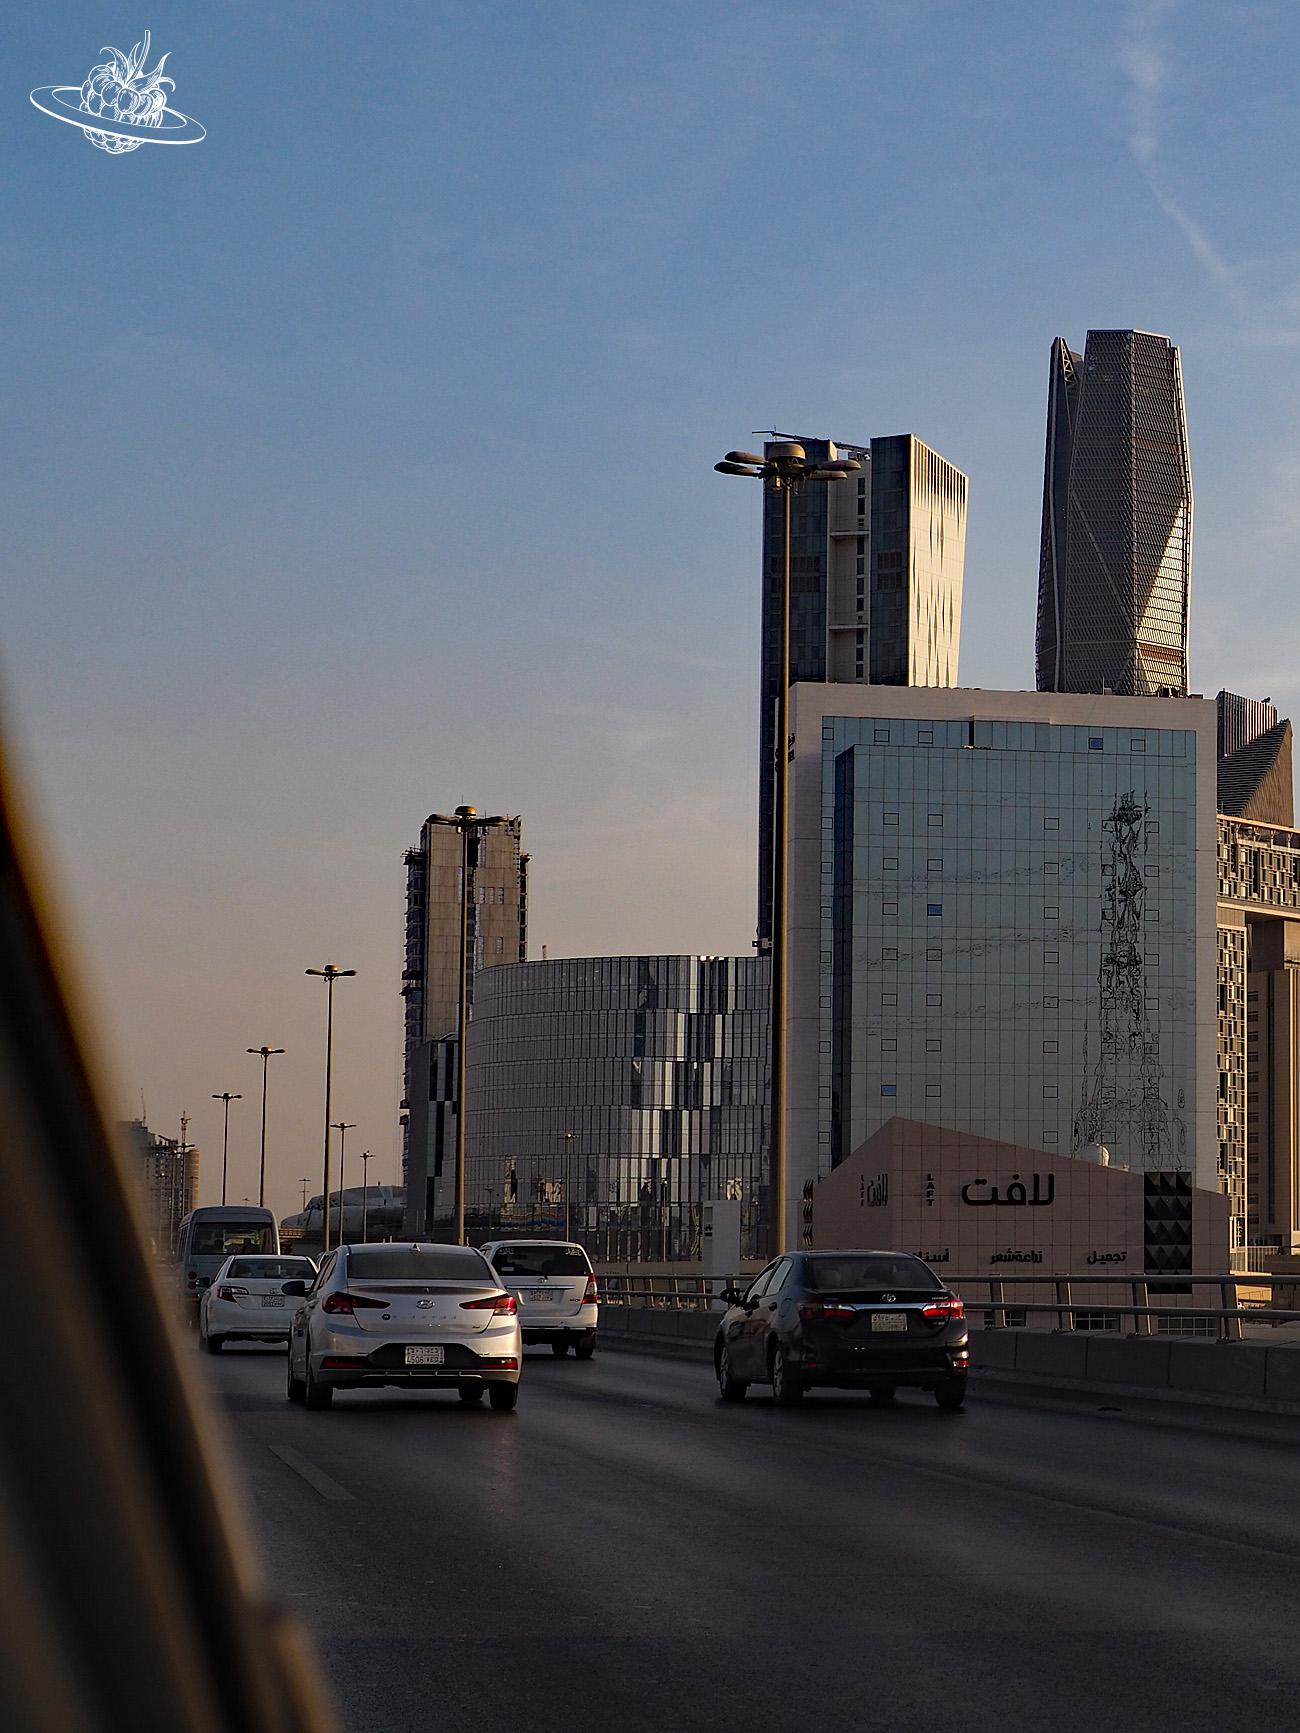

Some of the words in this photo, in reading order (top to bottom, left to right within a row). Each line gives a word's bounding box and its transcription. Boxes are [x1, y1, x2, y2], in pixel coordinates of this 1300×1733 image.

[926, 1173, 935, 1206] LAFT
[962, 1173, 1055, 1206] لافت
[912, 1248, 949, 1262] أسنا
[1087, 1251, 1127, 1264] تجميل
